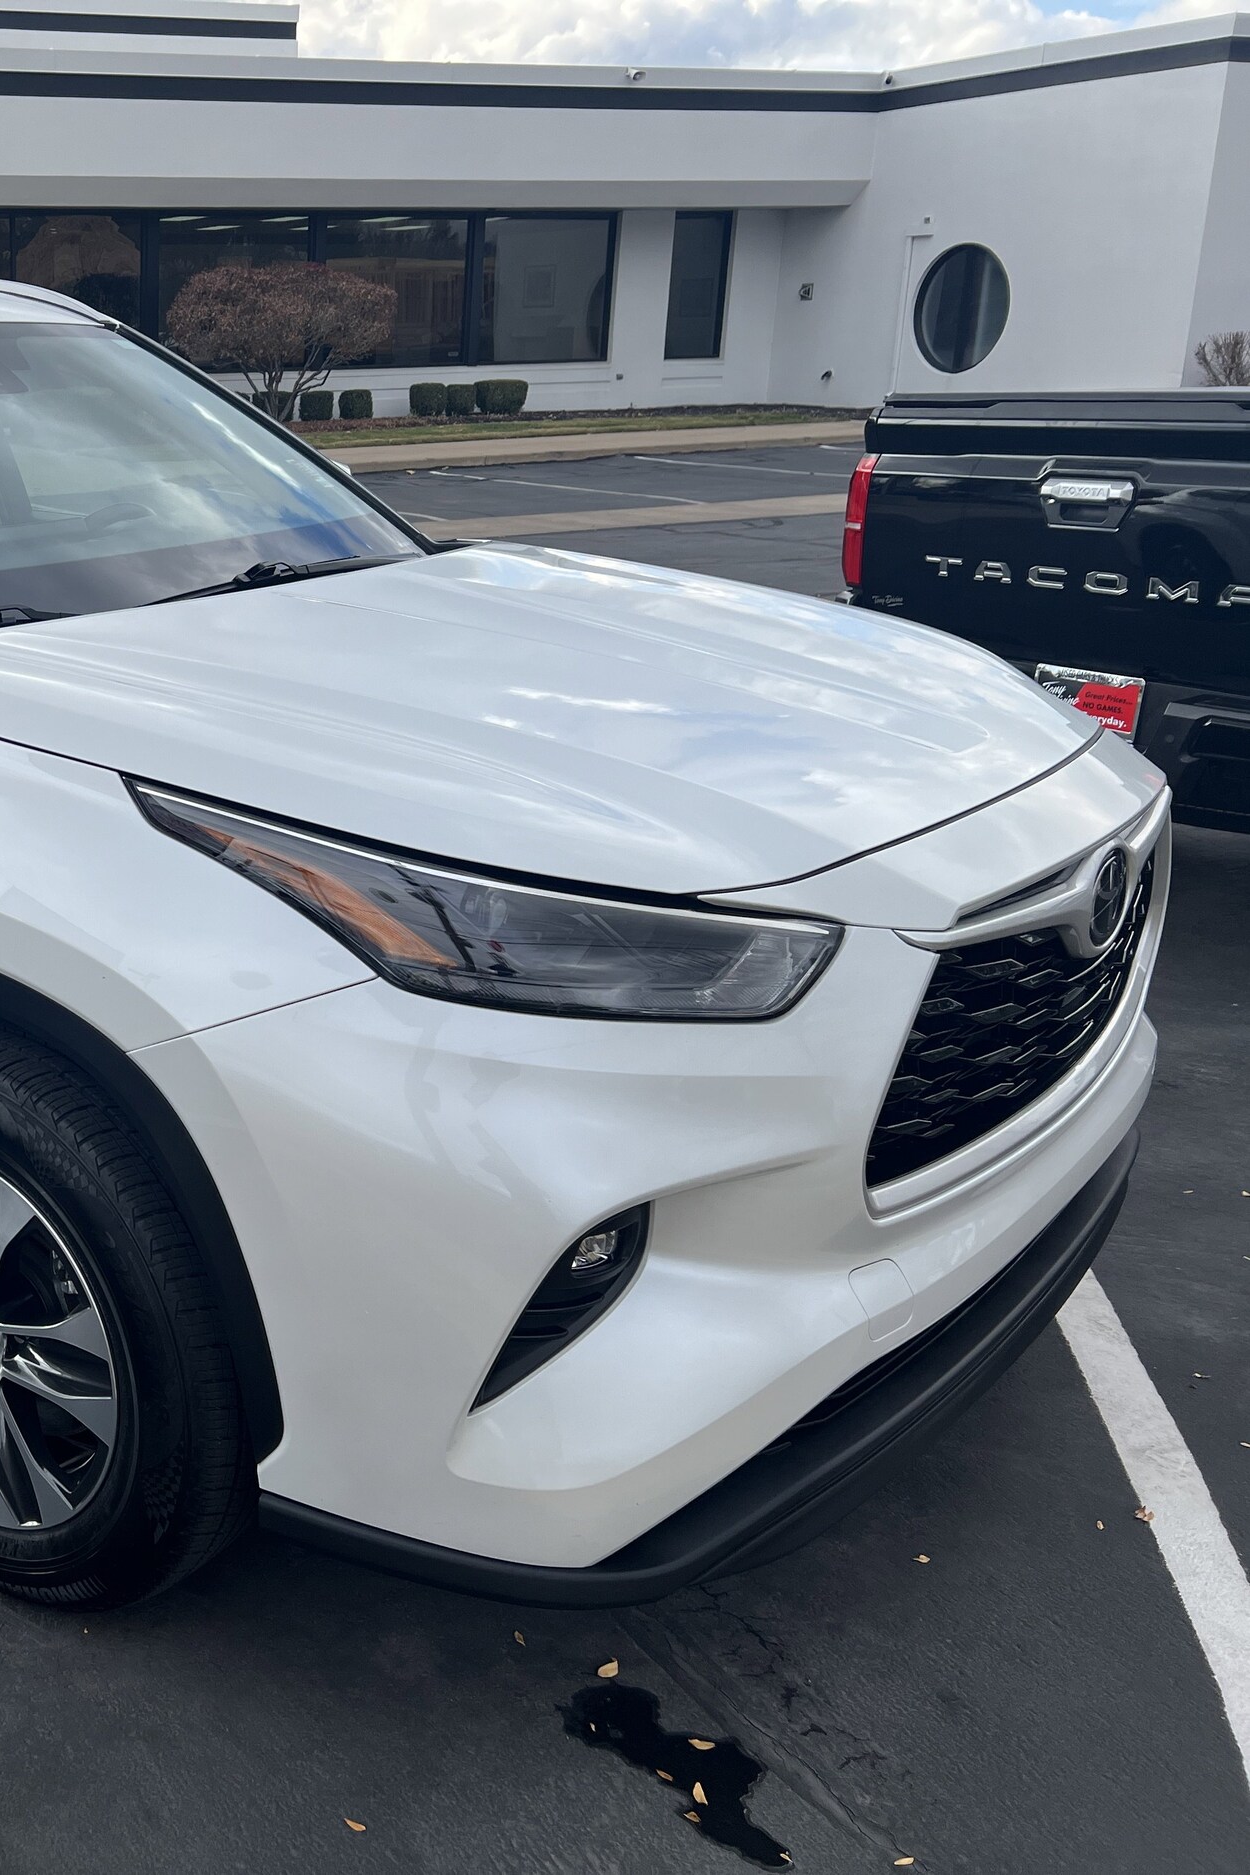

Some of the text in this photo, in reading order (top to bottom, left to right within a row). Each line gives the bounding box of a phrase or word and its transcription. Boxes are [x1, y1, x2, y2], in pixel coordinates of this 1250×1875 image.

[1061, 486, 1105, 498] TOYOTA
[1084, 690, 1105, 701] Great
[1082, 700, 1124, 715] NO GAMES.
